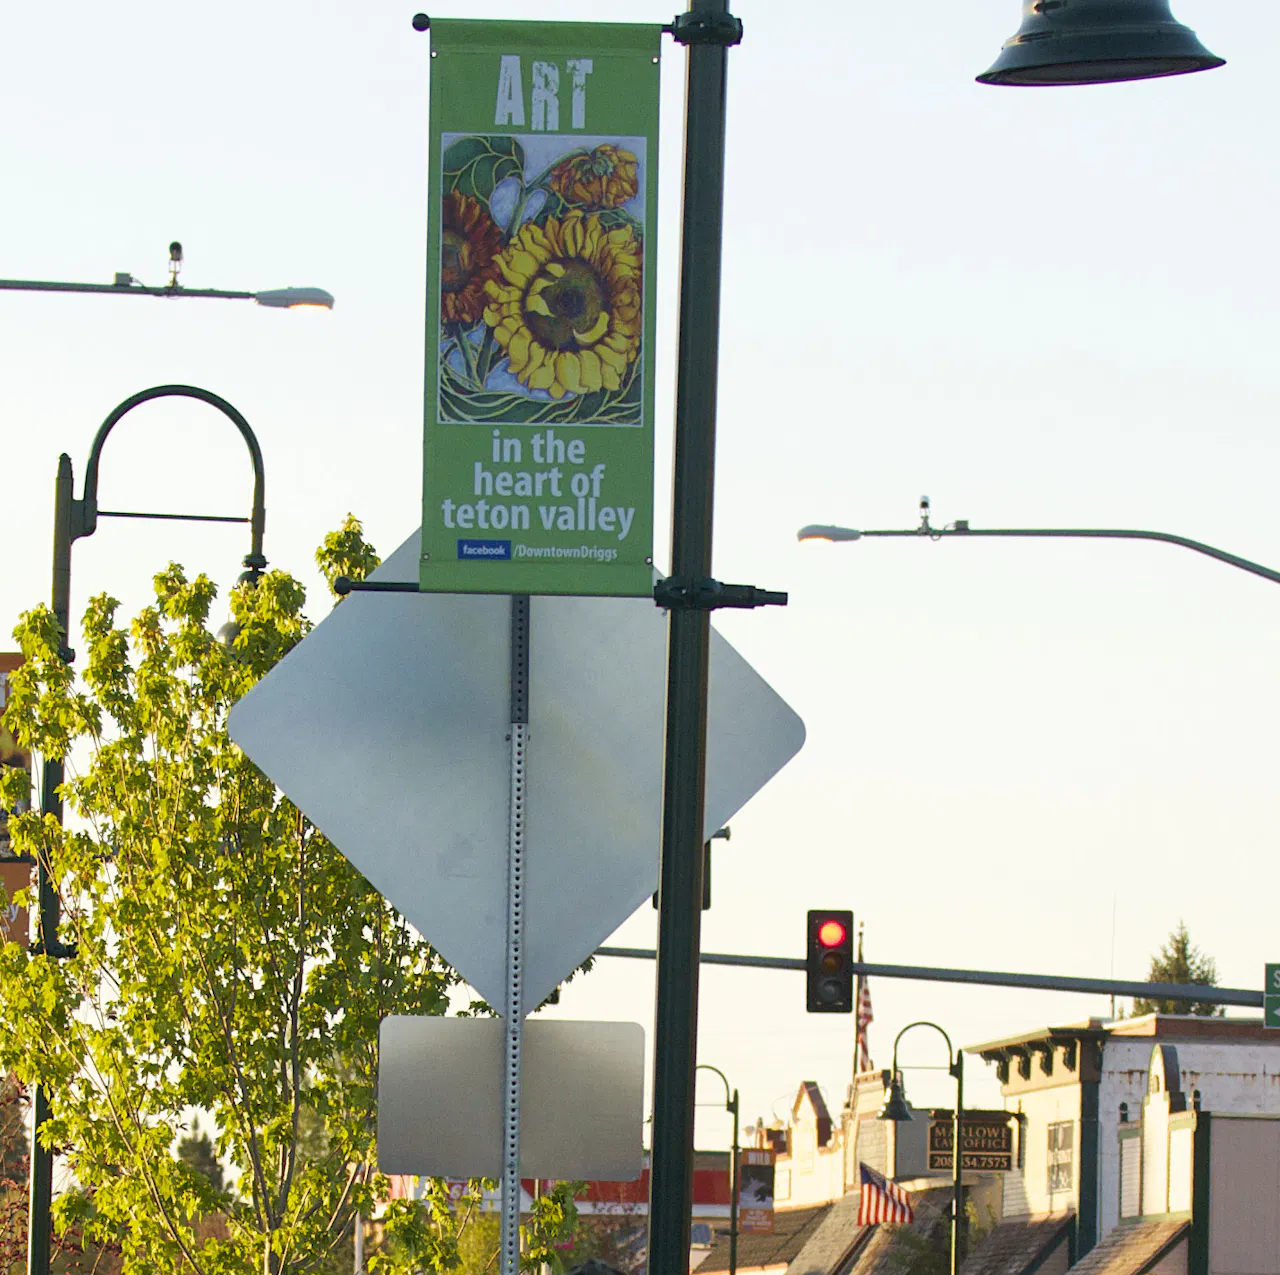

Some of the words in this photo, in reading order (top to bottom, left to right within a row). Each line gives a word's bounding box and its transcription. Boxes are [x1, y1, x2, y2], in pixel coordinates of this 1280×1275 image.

[494, 54, 594, 131] ART
[491, 429, 522, 463] in
[530, 430, 586, 464] the
[473, 461, 563, 497] heart
[570, 463, 606, 498] of
[441, 498, 531, 530] teton
[538, 497, 636, 541] valley
[462, 544, 506, 556] facebook
